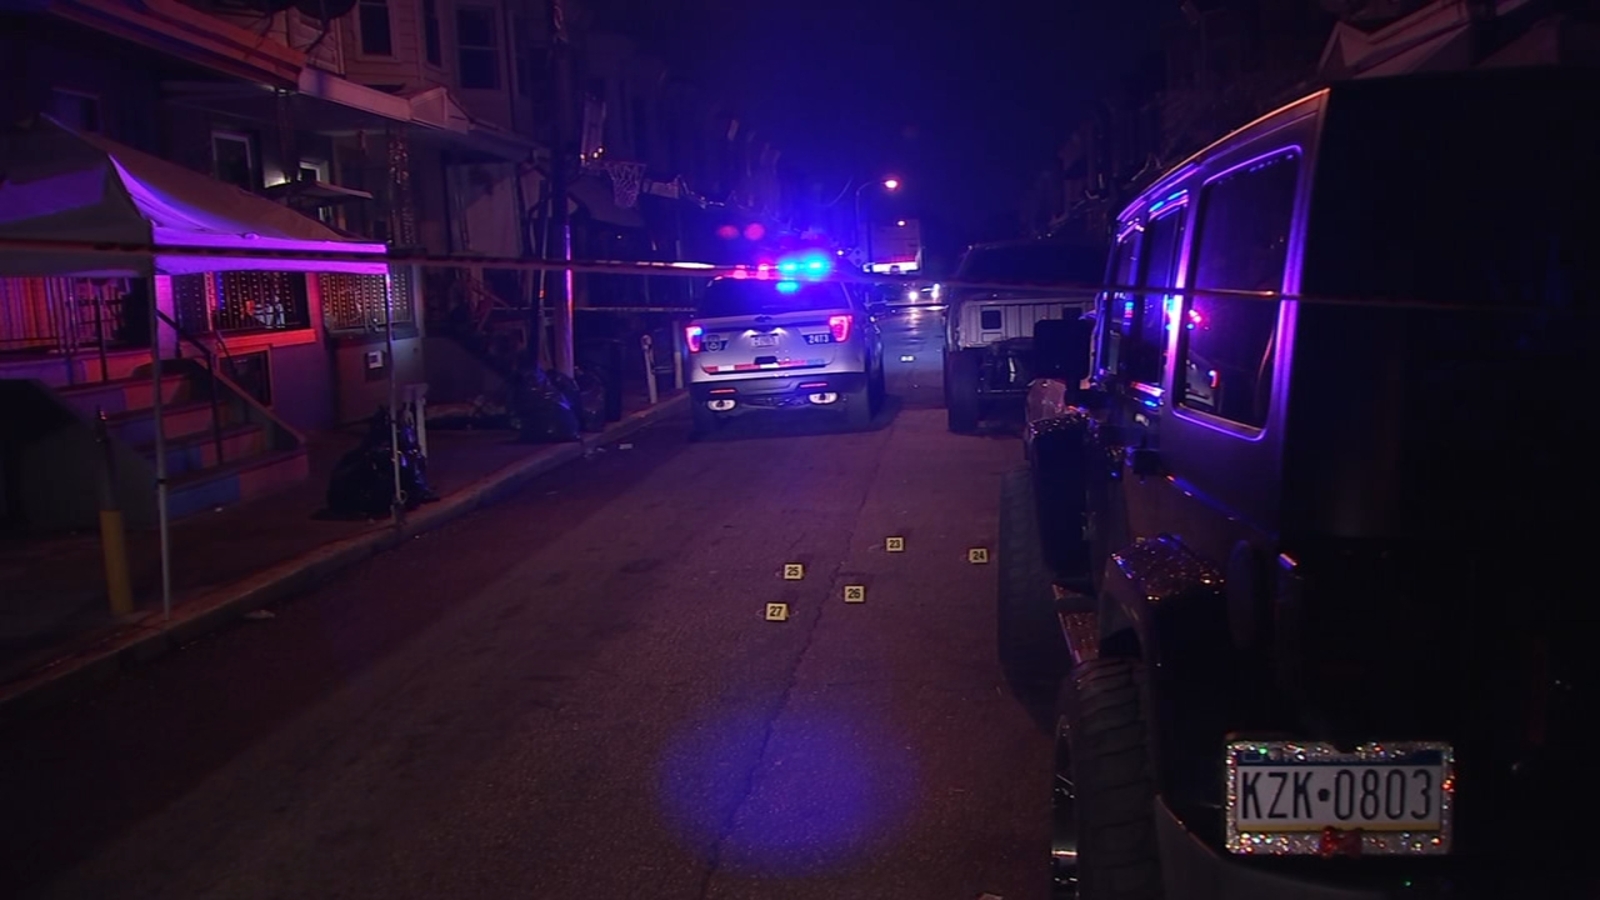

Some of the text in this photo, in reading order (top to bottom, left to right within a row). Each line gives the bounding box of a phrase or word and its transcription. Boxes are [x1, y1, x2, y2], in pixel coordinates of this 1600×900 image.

[889, 540, 901, 549] 23
[973, 551, 985, 560] 24
[787, 567, 799, 576] 25
[848, 589, 861, 599] 26
[769, 606, 783, 617] 27
